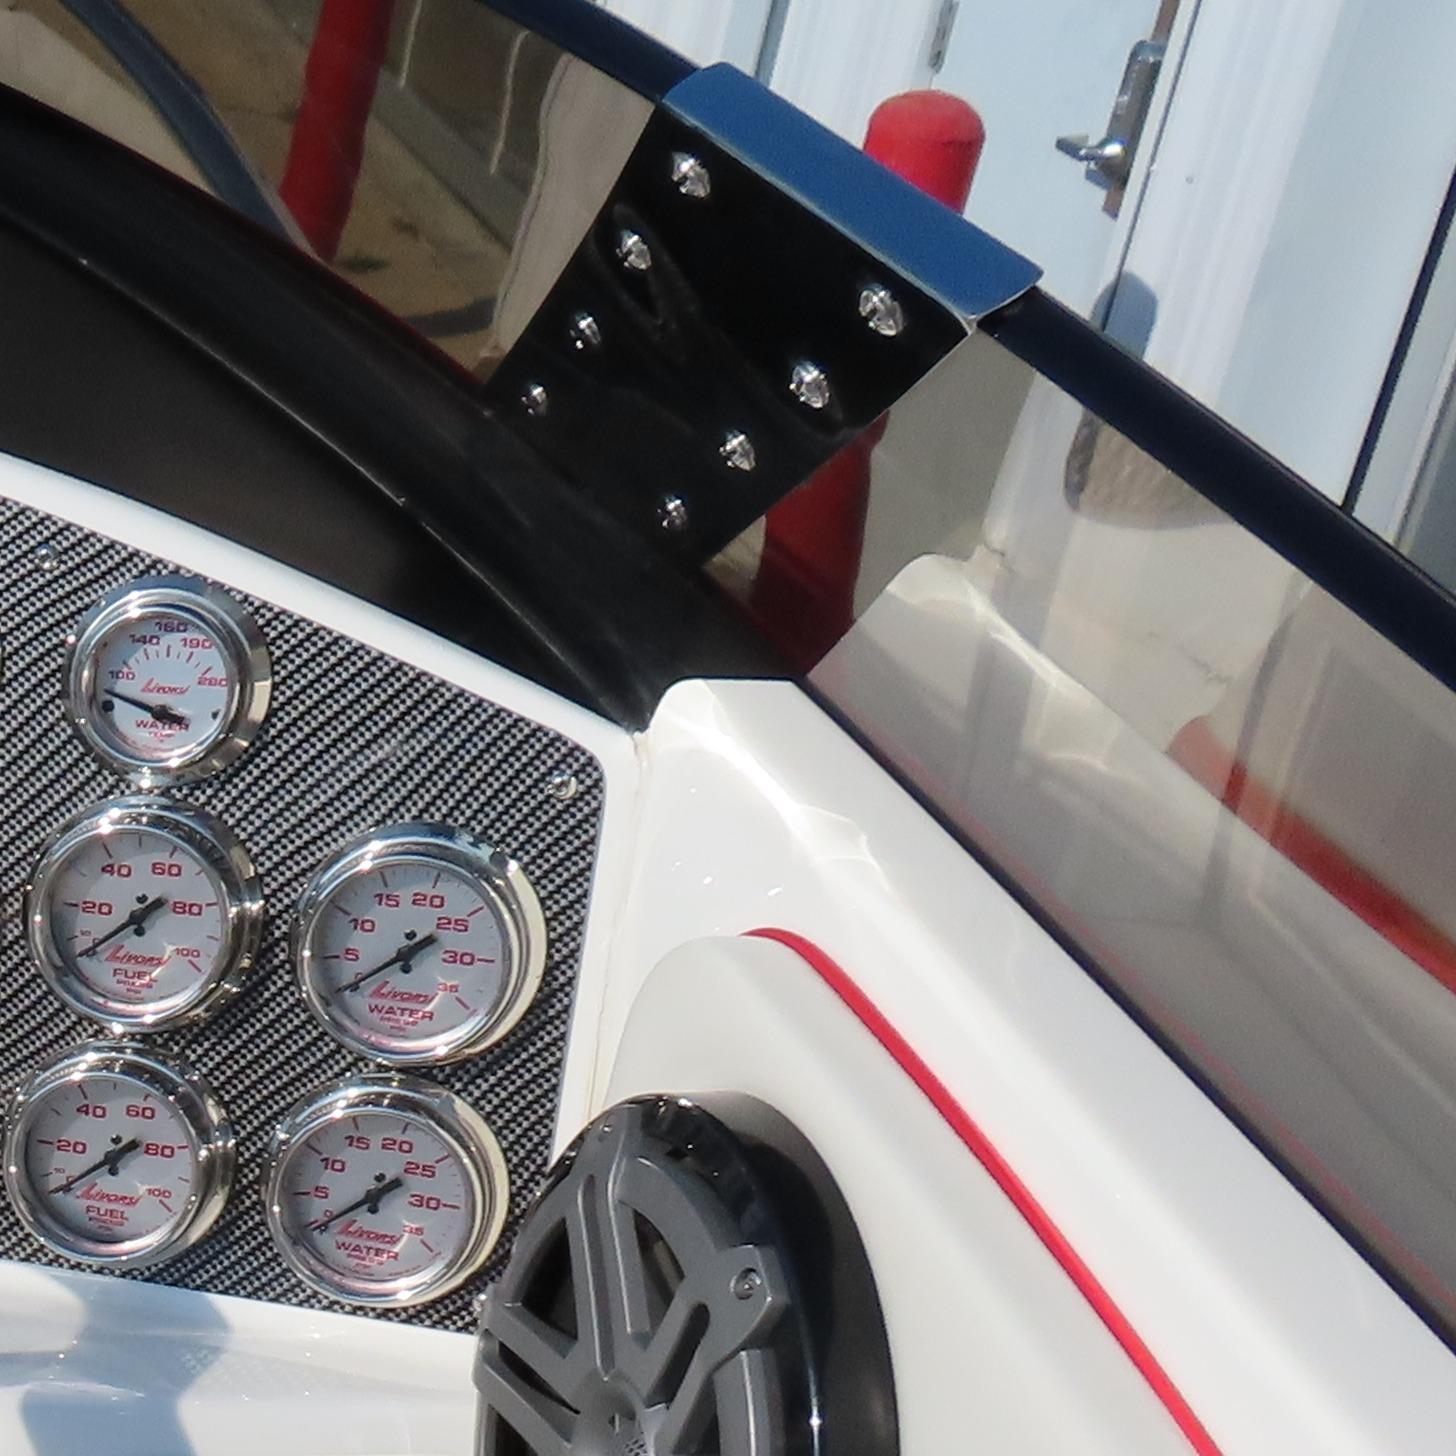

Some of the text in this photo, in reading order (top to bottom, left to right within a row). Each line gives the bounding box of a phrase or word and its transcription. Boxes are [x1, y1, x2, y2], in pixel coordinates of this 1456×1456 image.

[155, 622, 188, 633] 160
[129, 635, 160, 644] 140
[109, 671, 135, 680] 100
[136, 720, 190, 731] WATER
[101, 863, 132, 878] 40
[151, 862, 182, 877] 60
[374, 893, 400, 908] 15
[411, 893, 445, 908] 20
[81, 901, 113, 915] 20
[172, 901, 202, 916] 80
[349, 919, 376, 932] 10
[436, 917, 469, 932] 25
[175, 947, 200, 957] 100
[344, 948, 359, 961] 5
[442, 950, 475, 966] 30
[113, 968, 158, 981] FUEL
[438, 983, 459, 993] 35
[368, 1004, 434, 1021] WATER
[76, 1104, 106, 1118] 40
[126, 1105, 156, 1119] 60
[56, 1140, 87, 1154] 20
[344, 1135, 370, 1150] 15
[381, 1137, 413, 1153] 20
[144, 1144, 174, 1158] 80
[320, 1158, 346, 1172] 10
[404, 1161, 437, 1178] 25
[146, 1188, 172, 1198] 100
[314, 1186, 330, 1199] 5
[408, 1194, 442, 1211] 30
[86, 1206, 129, 1221] FUEL
[402, 1225, 424, 1236] 35
[336, 1239, 399, 1261] WATER
